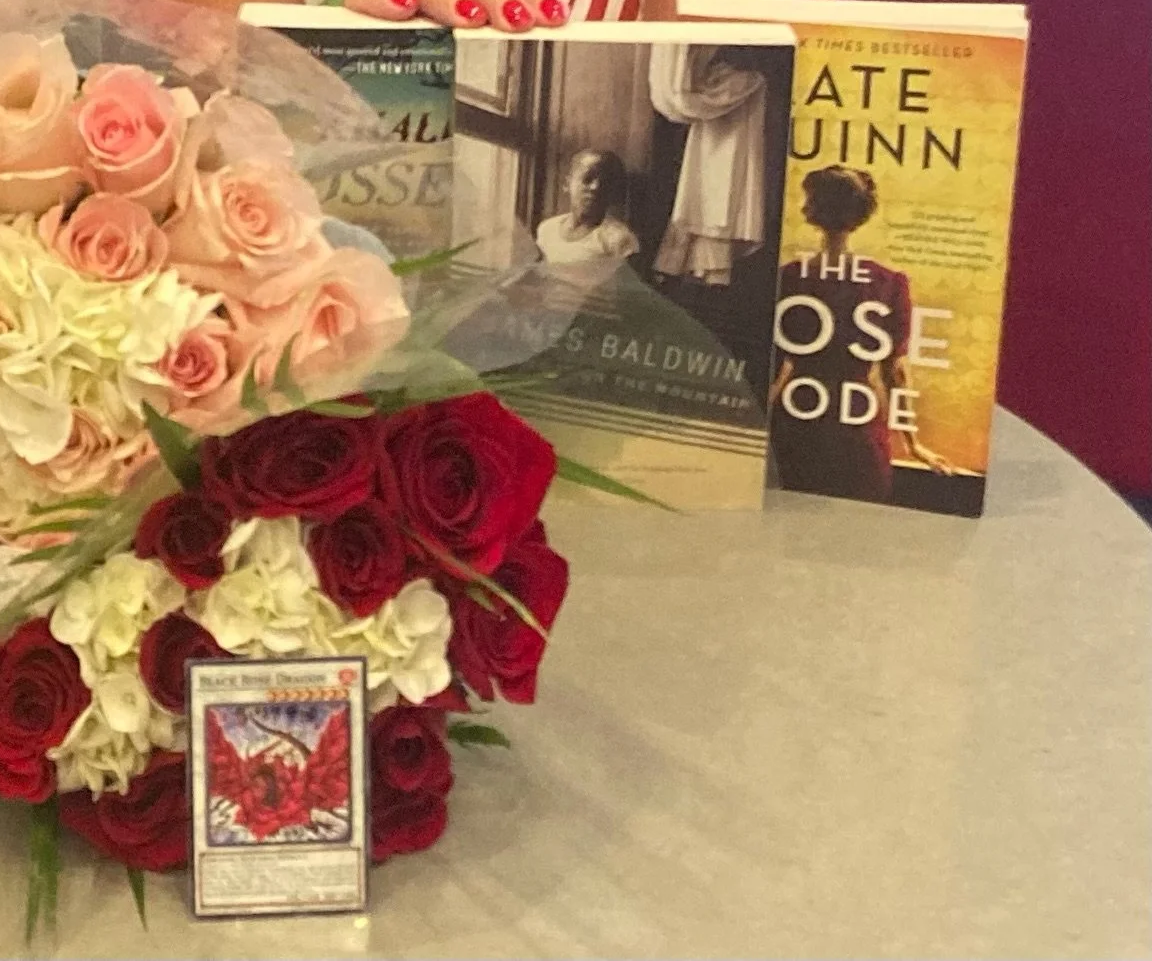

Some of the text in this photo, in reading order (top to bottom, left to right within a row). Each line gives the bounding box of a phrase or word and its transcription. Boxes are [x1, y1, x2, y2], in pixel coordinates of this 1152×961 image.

[815, 37, 866, 54] TIMES
[870, 39, 976, 60] BESTSELLER
[804, 64, 932, 114] ATE
[796, 251, 875, 284] THE
[773, 294, 954, 370] OSE
[600, 333, 747, 383] BALDWIN
[654, 380, 751, 408] MOUNTAIN
[781, 376, 921, 433] ODE
